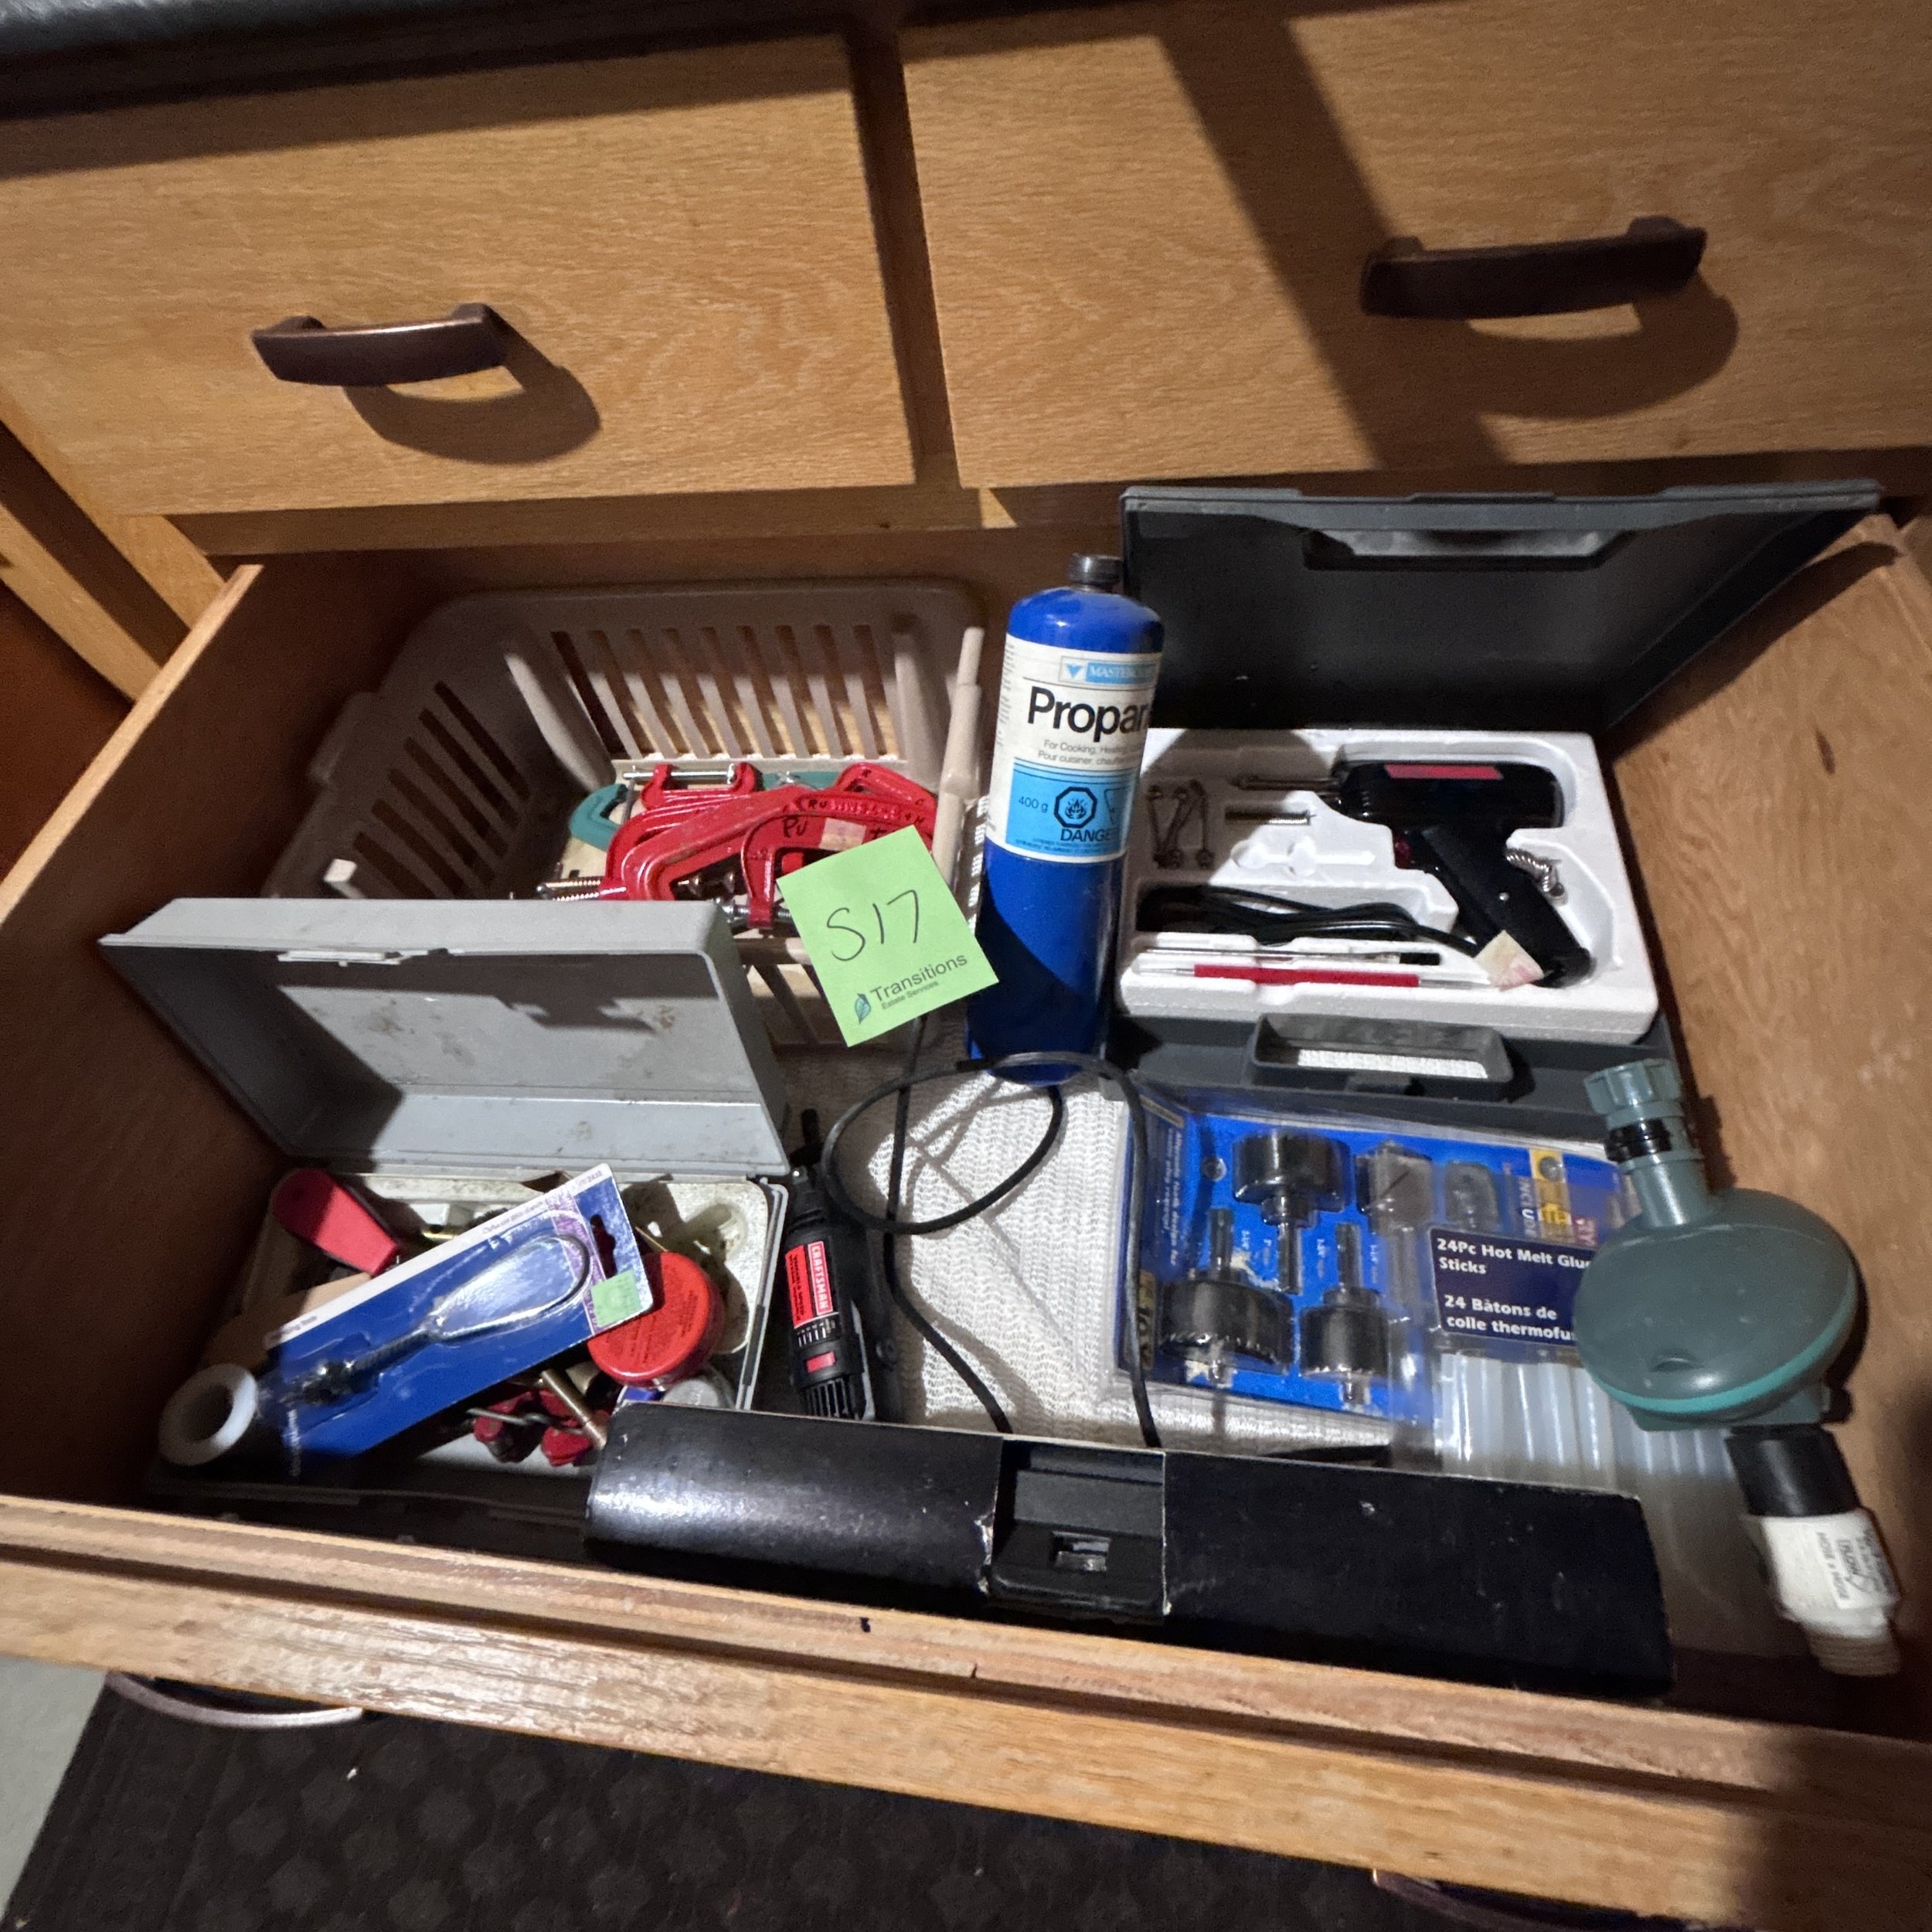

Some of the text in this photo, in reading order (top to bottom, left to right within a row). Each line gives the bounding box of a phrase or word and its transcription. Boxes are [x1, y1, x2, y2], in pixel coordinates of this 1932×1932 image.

[1028, 686, 1151, 743] Propan
[1039, 750, 1056, 760] Pour
[1044, 740, 1058, 748] For
[1018, 796, 1049, 814] 400 g
[826, 889, 920, 961] S17
[870, 954, 968, 1002] Transitions
[881, 980, 939, 1010] Estate Services
[1437, 1238, 1477, 1255] 24Pc
[1481, 1244, 1513, 1260] Hot
[1517, 1249, 1553, 1265] Melt
[811, 1245, 829, 1309] CRAFTSMAN
[1439, 1257, 1487, 1274] Sticks
[1444, 1294, 1557, 1320] 24 Bâtons de
[1447, 1316, 1487, 1331] colle
